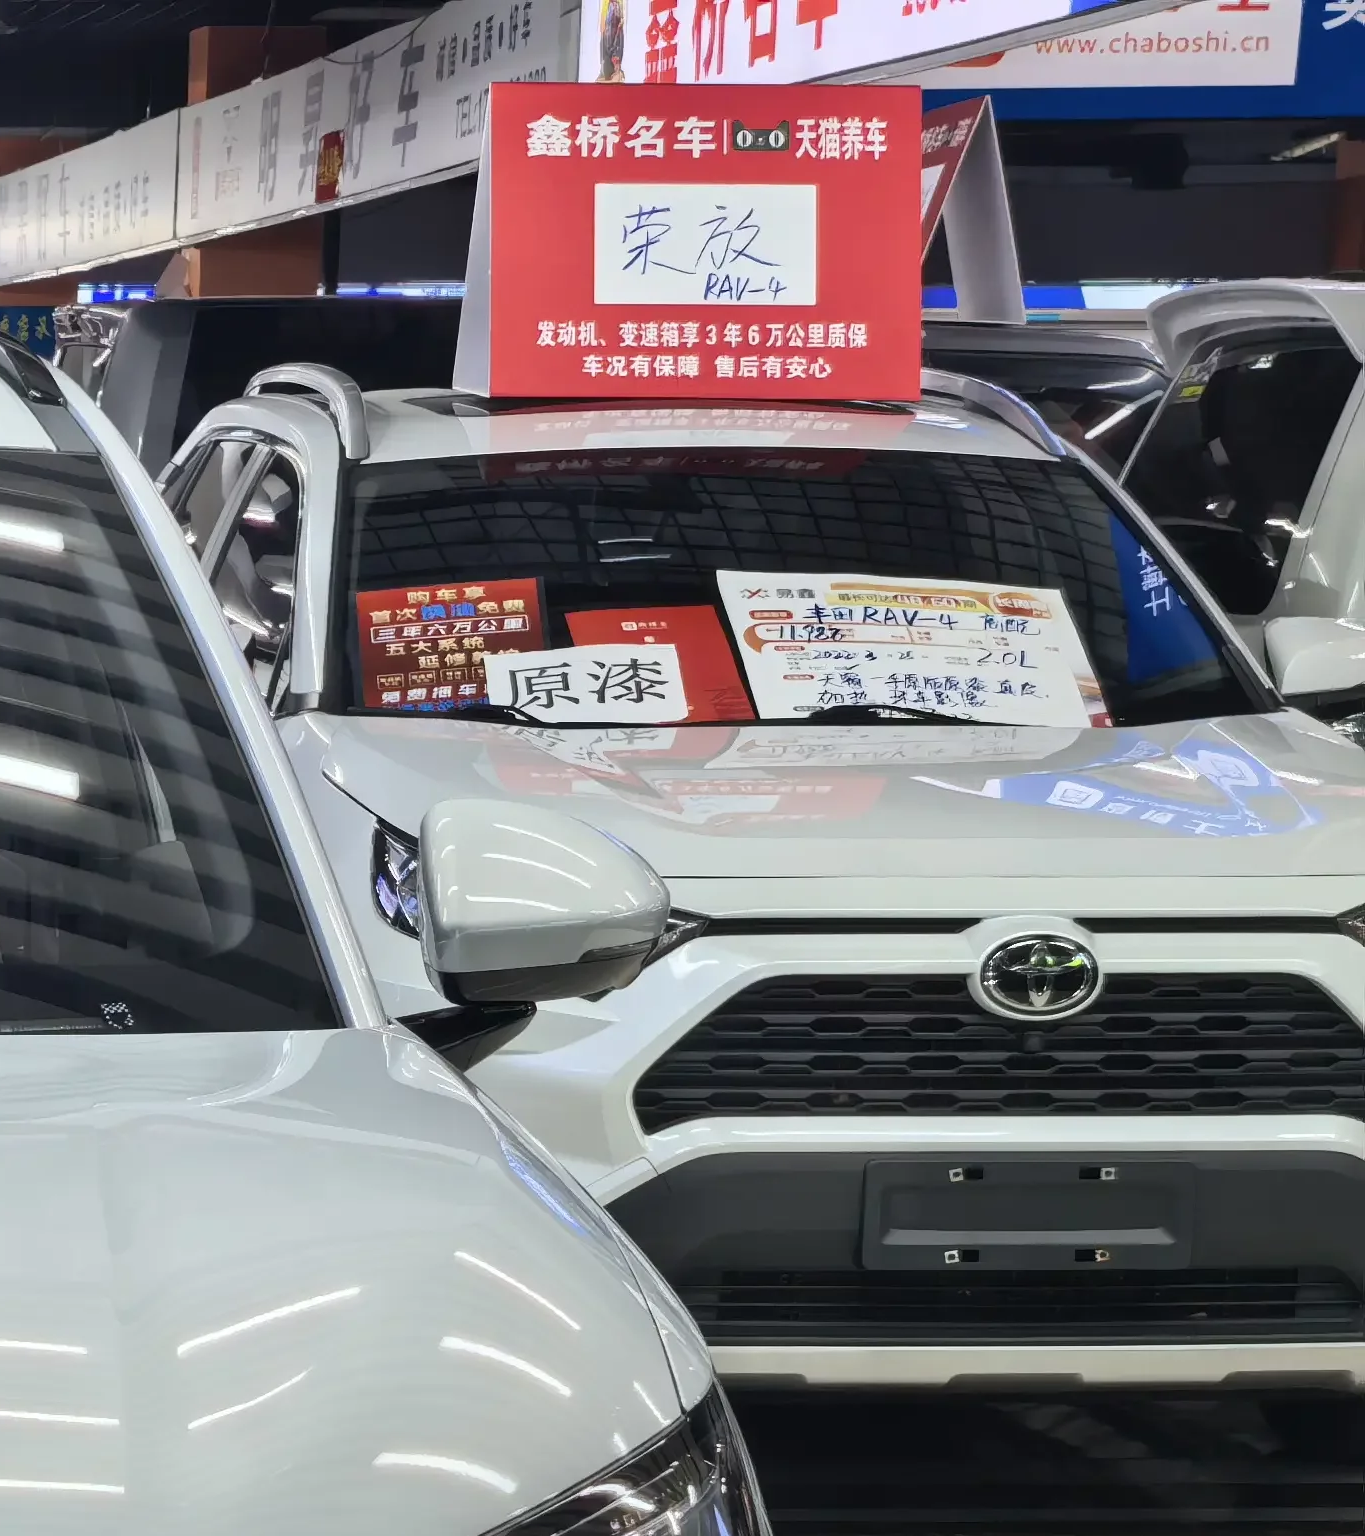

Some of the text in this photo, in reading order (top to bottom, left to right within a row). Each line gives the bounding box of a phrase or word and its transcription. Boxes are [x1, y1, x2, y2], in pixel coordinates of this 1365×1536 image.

[1034, 30, 1270, 55] www.chaboshi.cn
[525, 114, 718, 159] 鑫桥名车
[795, 117, 888, 160] 天猫养车
[621, 204, 782, 277] 荣放
[703, 273, 787, 302] RAV-4
[535, 321, 869, 350] 发动机、变速箱享3年6万公里质保
[581, 355, 833, 380] 车况有保障 售后有安心
[406, 585, 487, 605] 购车享
[374, 618, 524, 641] 三年六万公里
[802, 603, 854, 624] 丰田
[861, 606, 959, 630] RAV-4
[385, 636, 486, 657] 五大系统
[508, 657, 670, 710] 原漆
